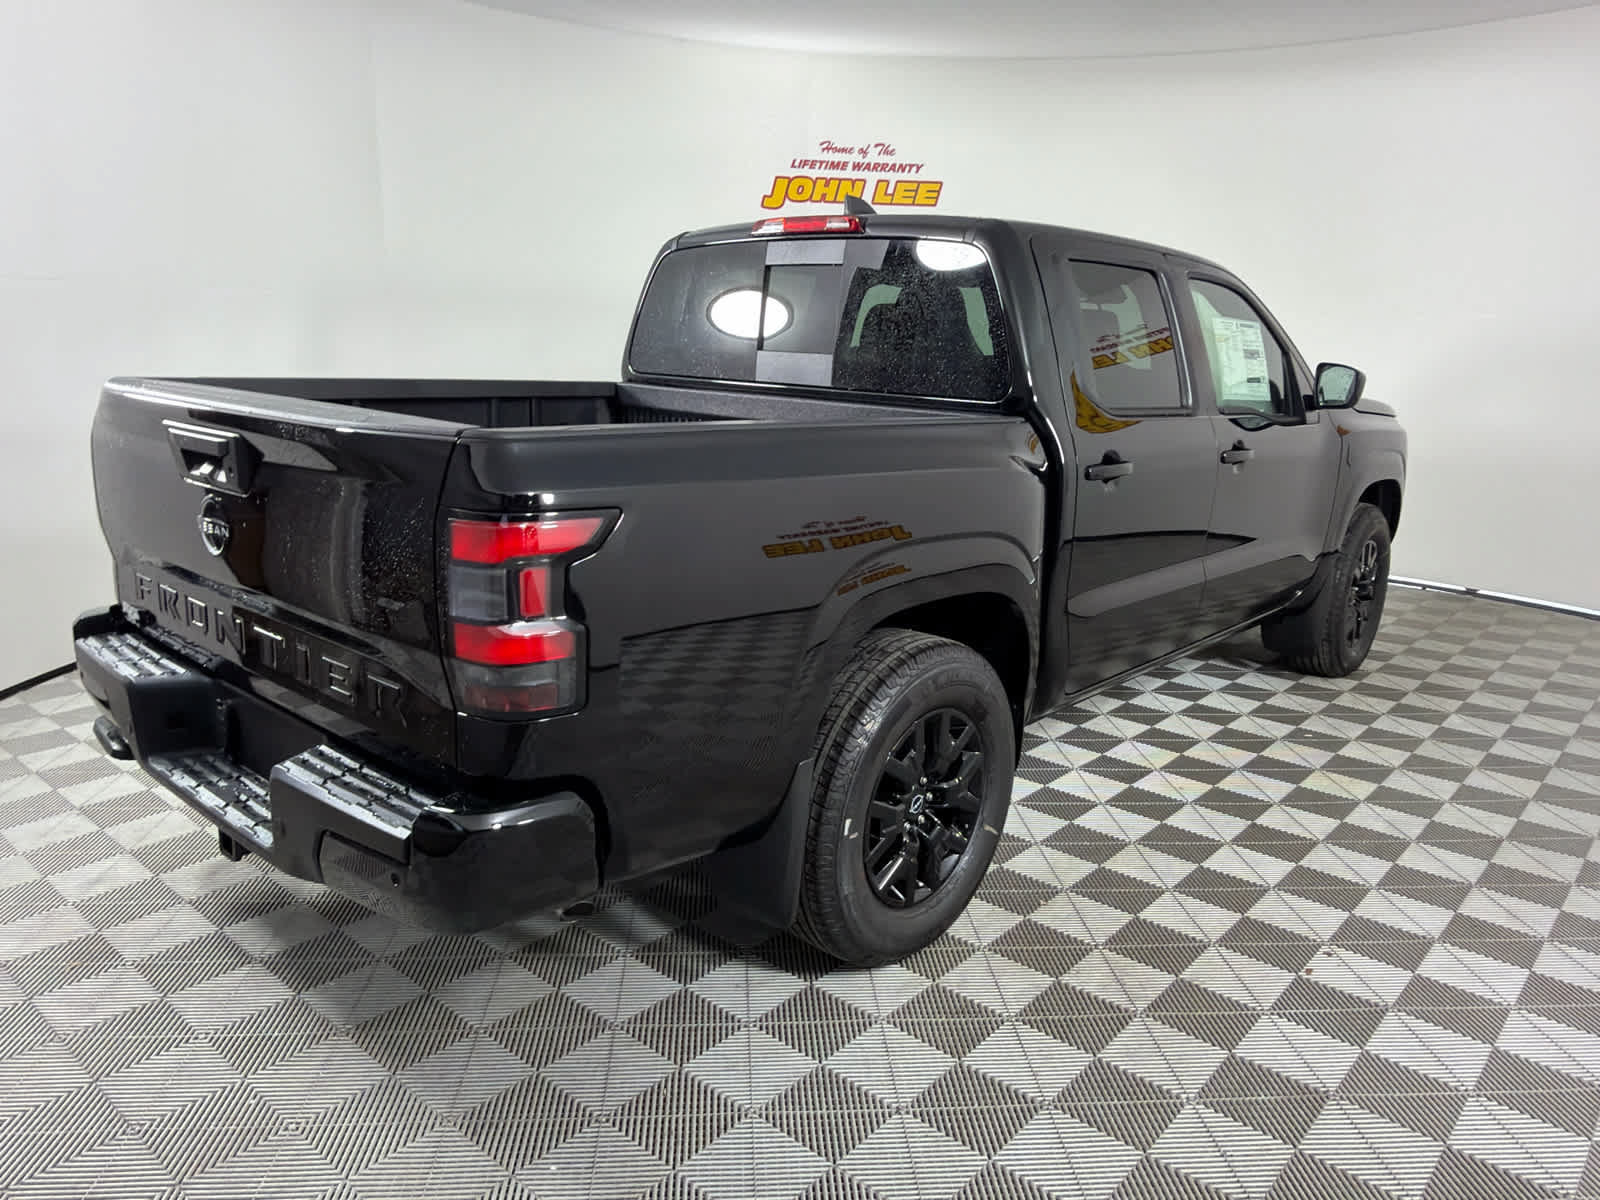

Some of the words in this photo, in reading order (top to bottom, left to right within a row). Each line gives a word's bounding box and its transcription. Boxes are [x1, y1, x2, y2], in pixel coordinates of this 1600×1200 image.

[819, 140, 855, 155] Home
[857, 144, 871, 159] of
[873, 143, 896, 156] The
[790, 158, 849, 171] LIFETIME
[851, 161, 924, 174] WARRANTY
[761, 176, 866, 209] JOHN
[872, 179, 943, 207] LEE
[135, 572, 407, 728] FRONTIER
